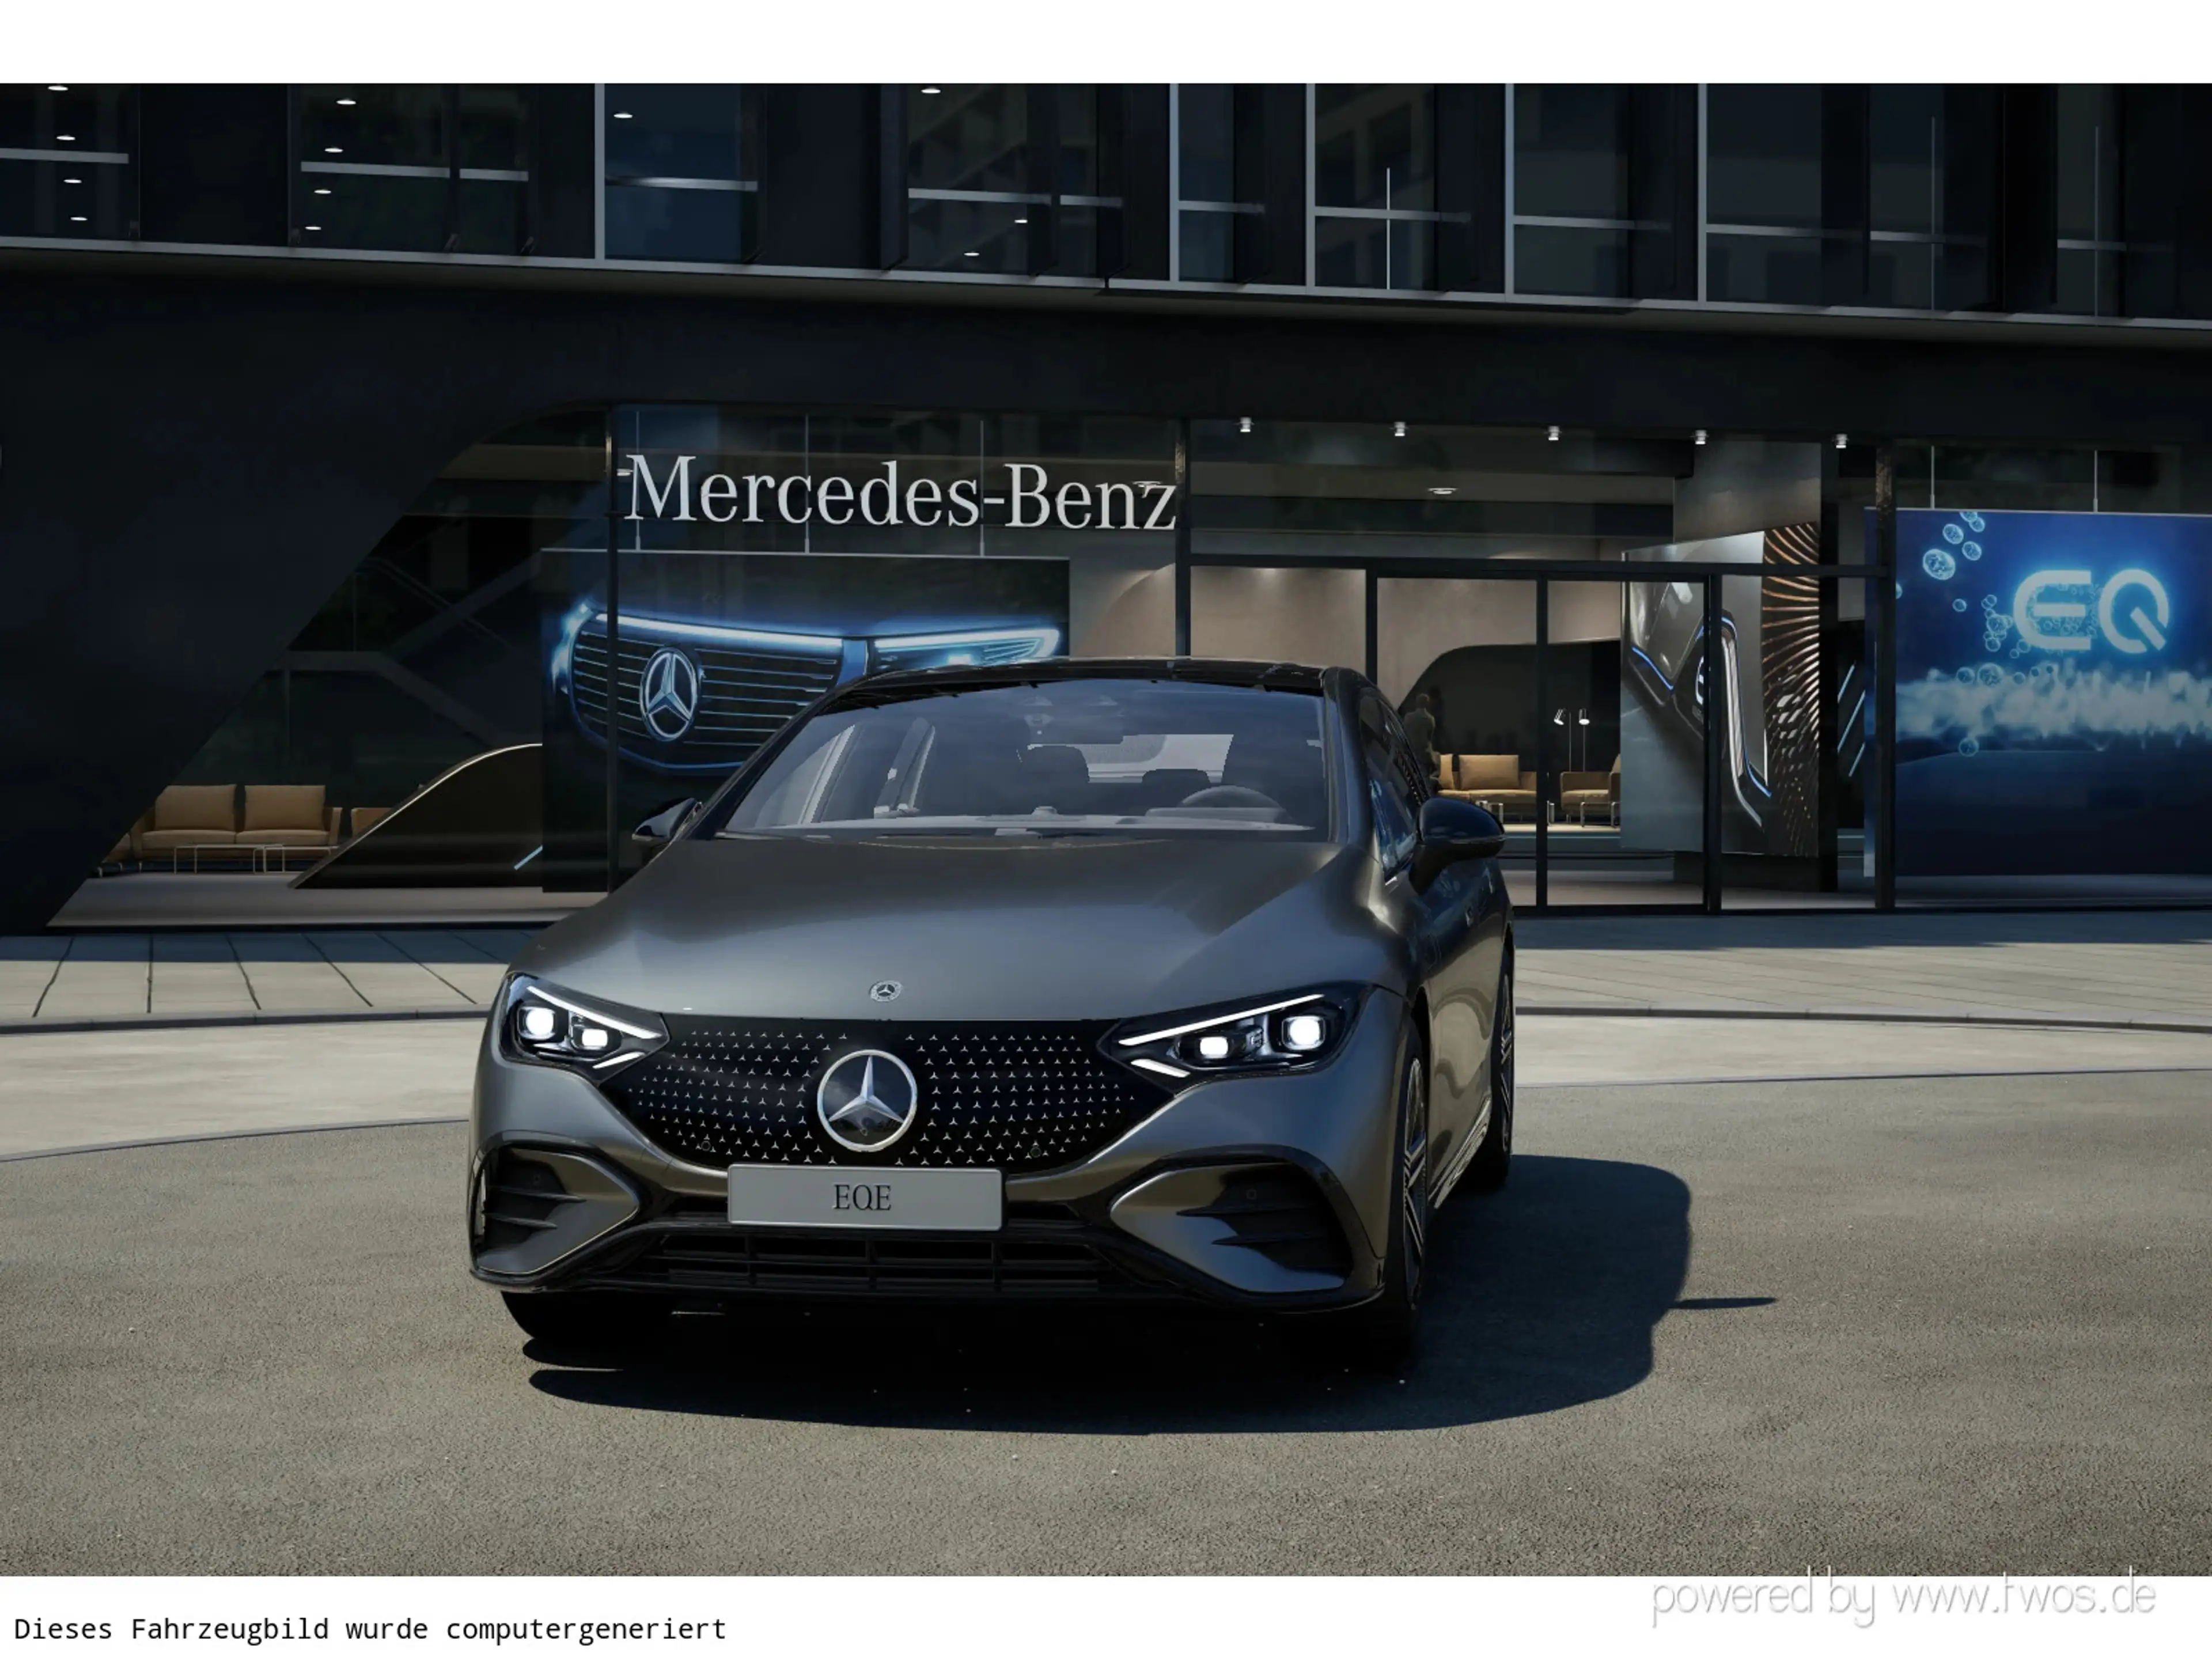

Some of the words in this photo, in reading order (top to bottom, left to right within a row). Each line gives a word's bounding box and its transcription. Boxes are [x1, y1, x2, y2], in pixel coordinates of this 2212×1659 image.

[624, 453, 1178, 531] Mercedes-Benz
[2013, 569, 2169, 654] EQ
[834, 1184, 892, 1211] EQE
